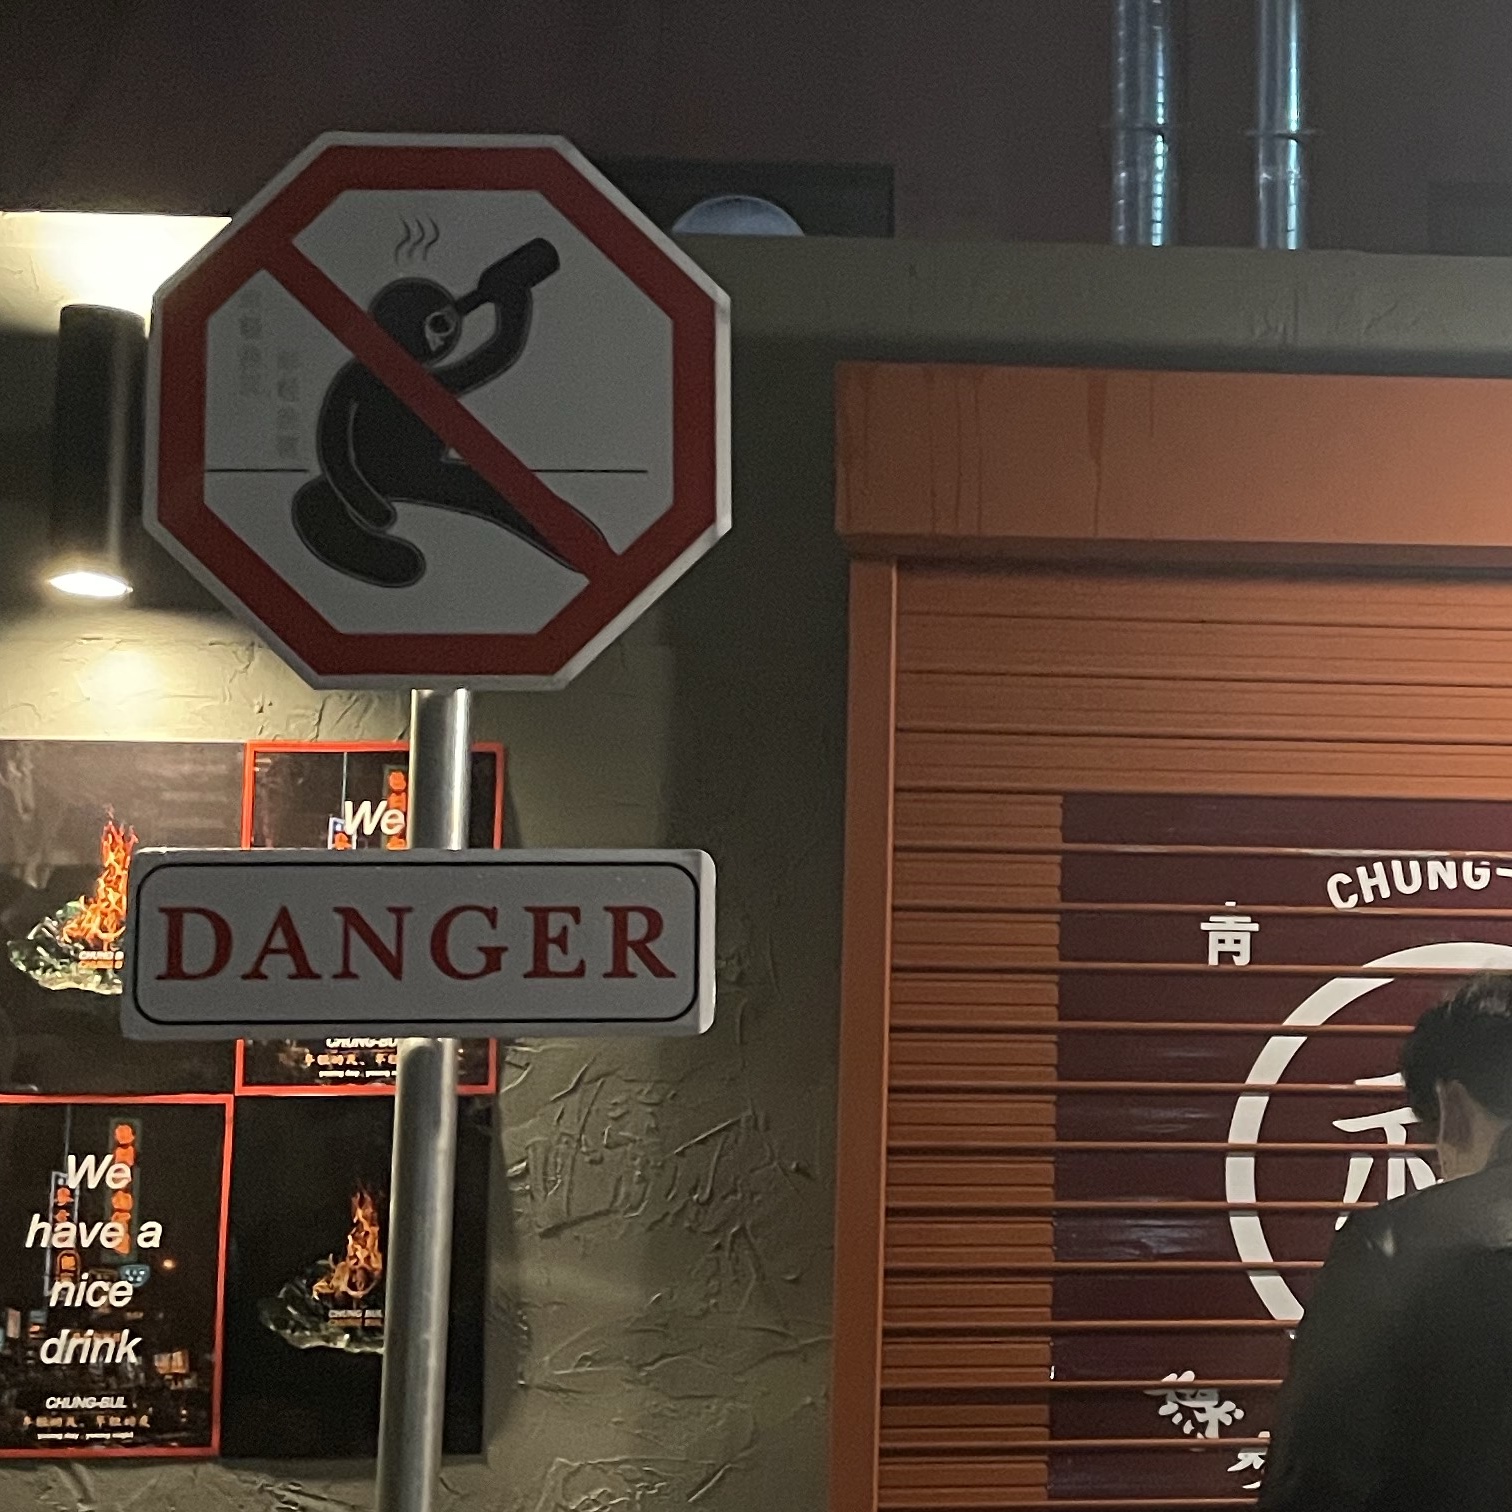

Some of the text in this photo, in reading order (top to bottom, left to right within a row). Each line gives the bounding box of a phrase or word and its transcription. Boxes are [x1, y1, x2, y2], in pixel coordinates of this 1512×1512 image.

[344, 800, 405, 836] We
[155, 904, 678, 982] DANGER
[67, 1154, 132, 1189] We
[25, 1213, 163, 1249] have a
[49, 1272, 133, 1307] nice
[40, 1328, 143, 1364] drink
[45, 1396, 127, 1409] CHUNG-BUL
